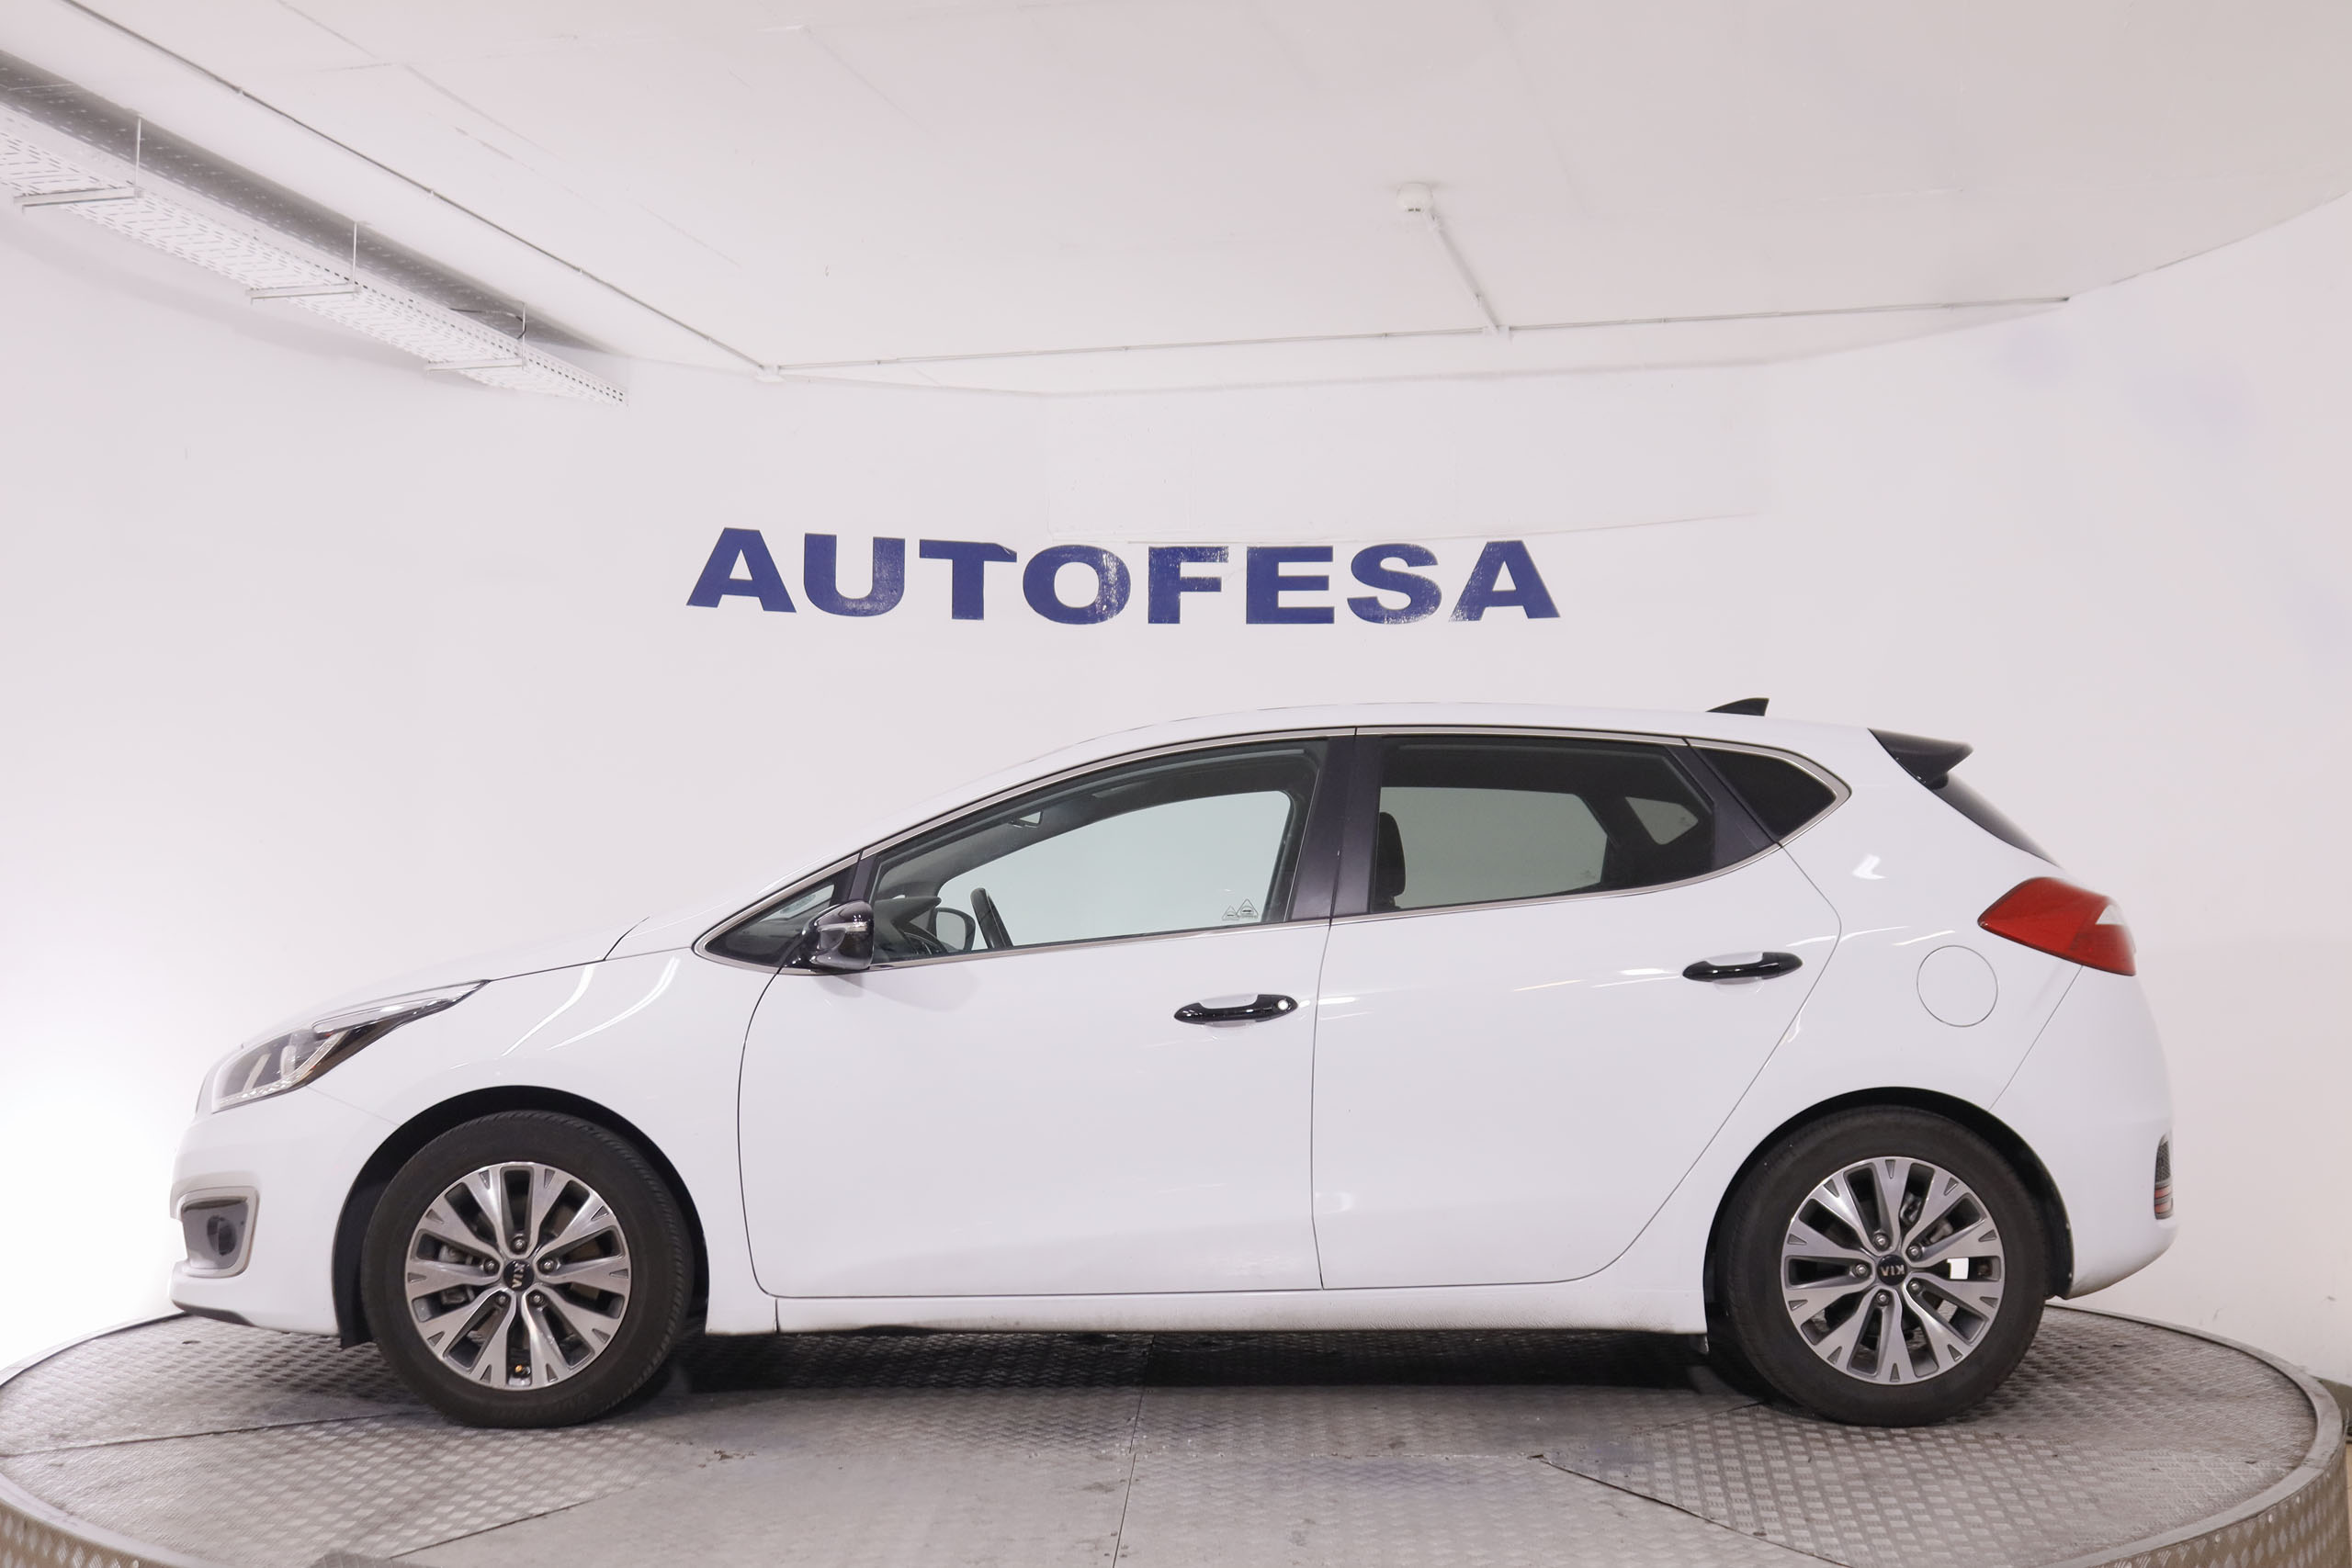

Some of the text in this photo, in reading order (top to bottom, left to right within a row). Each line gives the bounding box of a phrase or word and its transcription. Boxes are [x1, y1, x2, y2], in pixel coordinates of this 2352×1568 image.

[686, 527, 1560, 625] AUTOFESA
[512, 1262, 526, 1289] KIA
[1880, 1264, 1905, 1277] KIA
